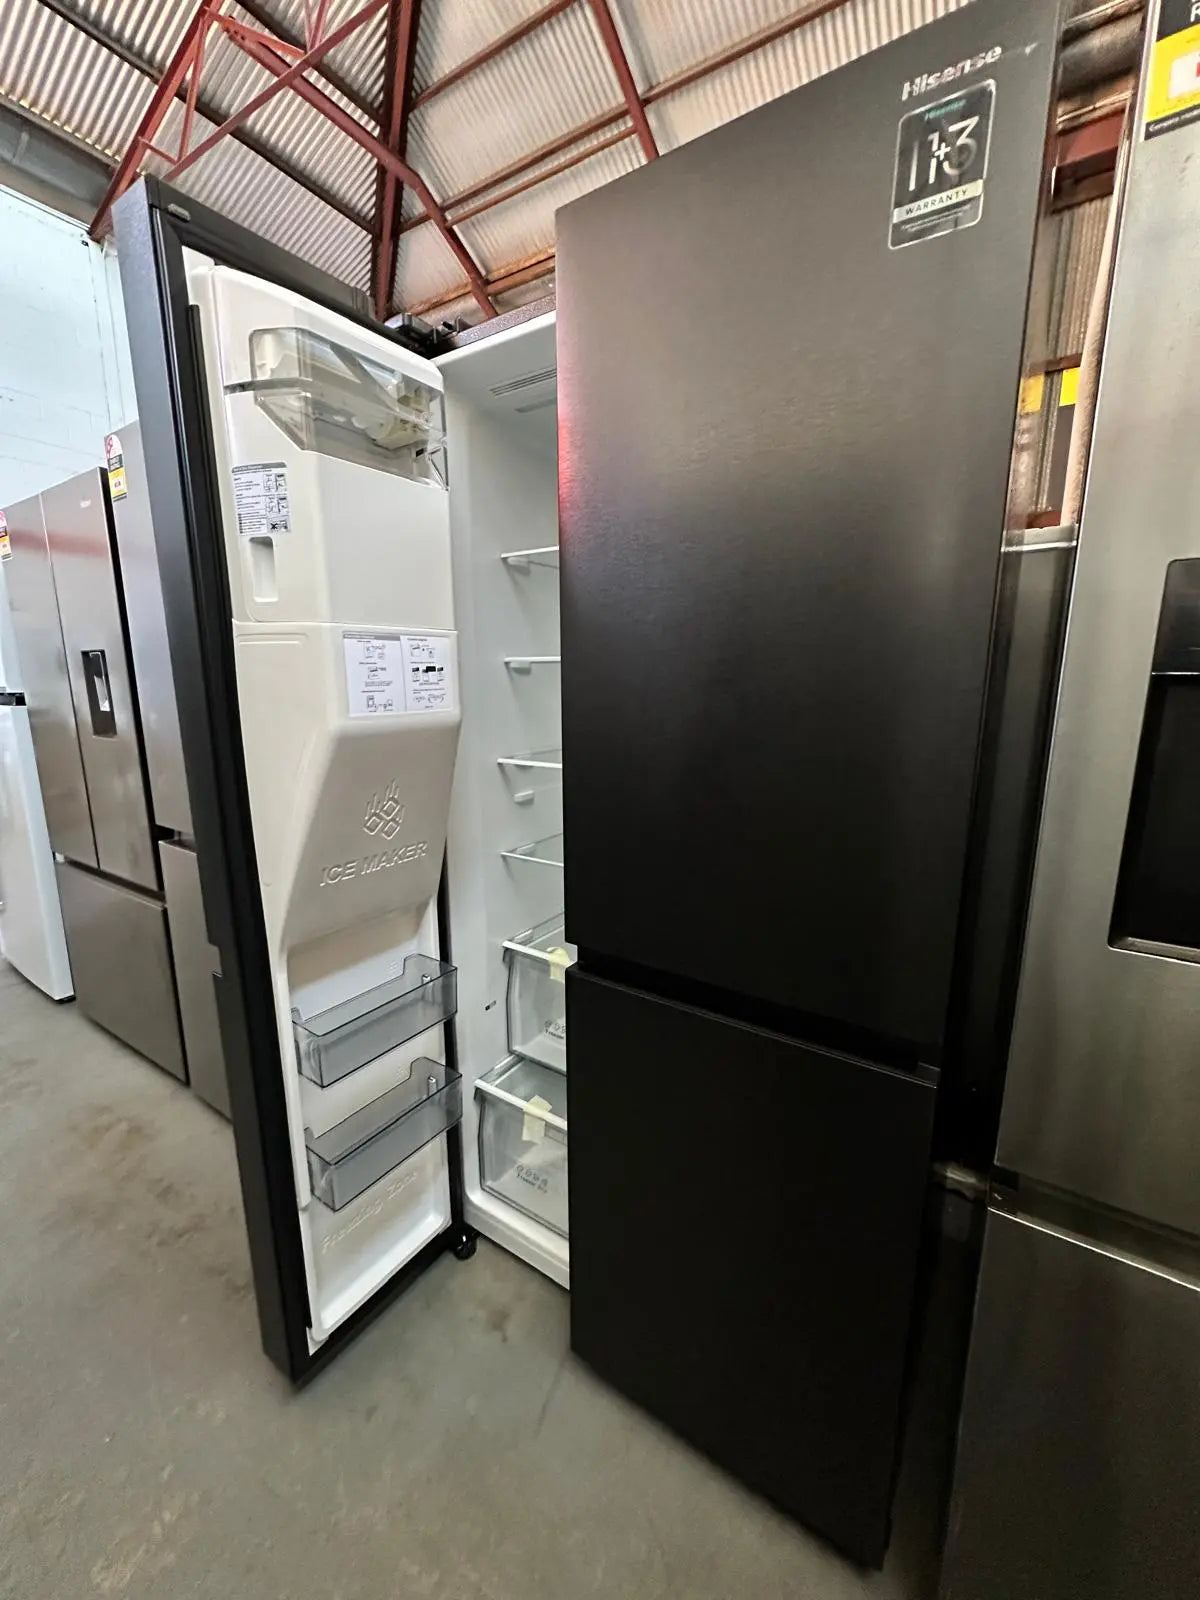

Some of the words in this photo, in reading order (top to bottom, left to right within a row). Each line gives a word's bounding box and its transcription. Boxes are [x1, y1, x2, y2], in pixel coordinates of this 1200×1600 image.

[902, 46, 1002, 101] Hisense
[906, 188, 967, 215] WARRANTY
[319, 860, 358, 886] ICE
[361, 842, 427, 875] MAKER
